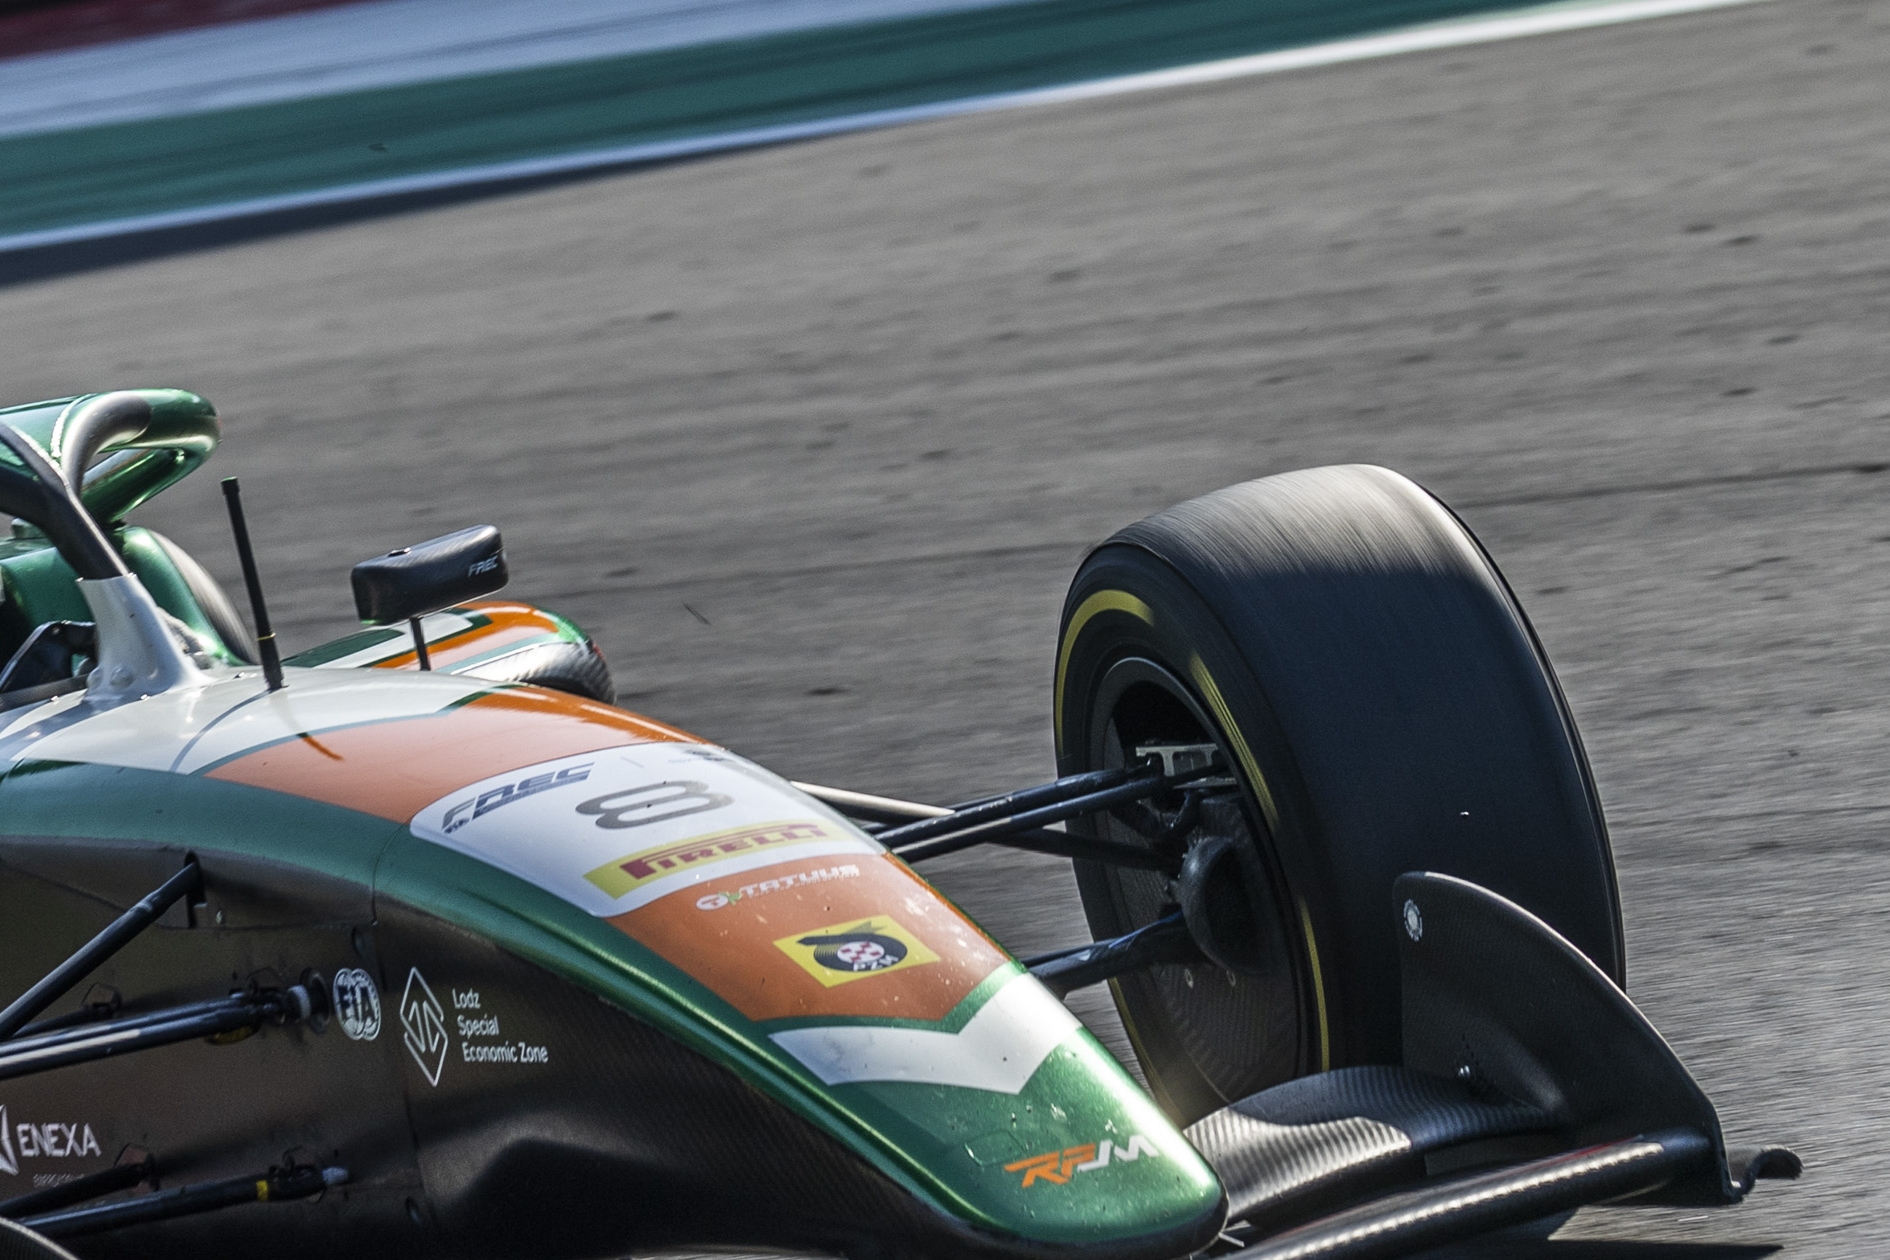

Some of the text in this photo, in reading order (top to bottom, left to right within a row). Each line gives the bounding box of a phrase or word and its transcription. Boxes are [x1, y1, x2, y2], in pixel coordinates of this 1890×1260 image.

[468, 555, 498, 577] FREC
[442, 762, 595, 829] FREC
[575, 780, 735, 829] 8
[619, 823, 828, 880] PIRELLI
[739, 864, 860, 898] TATUUS
[452, 988, 481, 1009] Lodz
[457, 1014, 499, 1038] Special
[462, 1041, 548, 1063] Economic Zone
[16, 1123, 101, 1157] ENEXA
